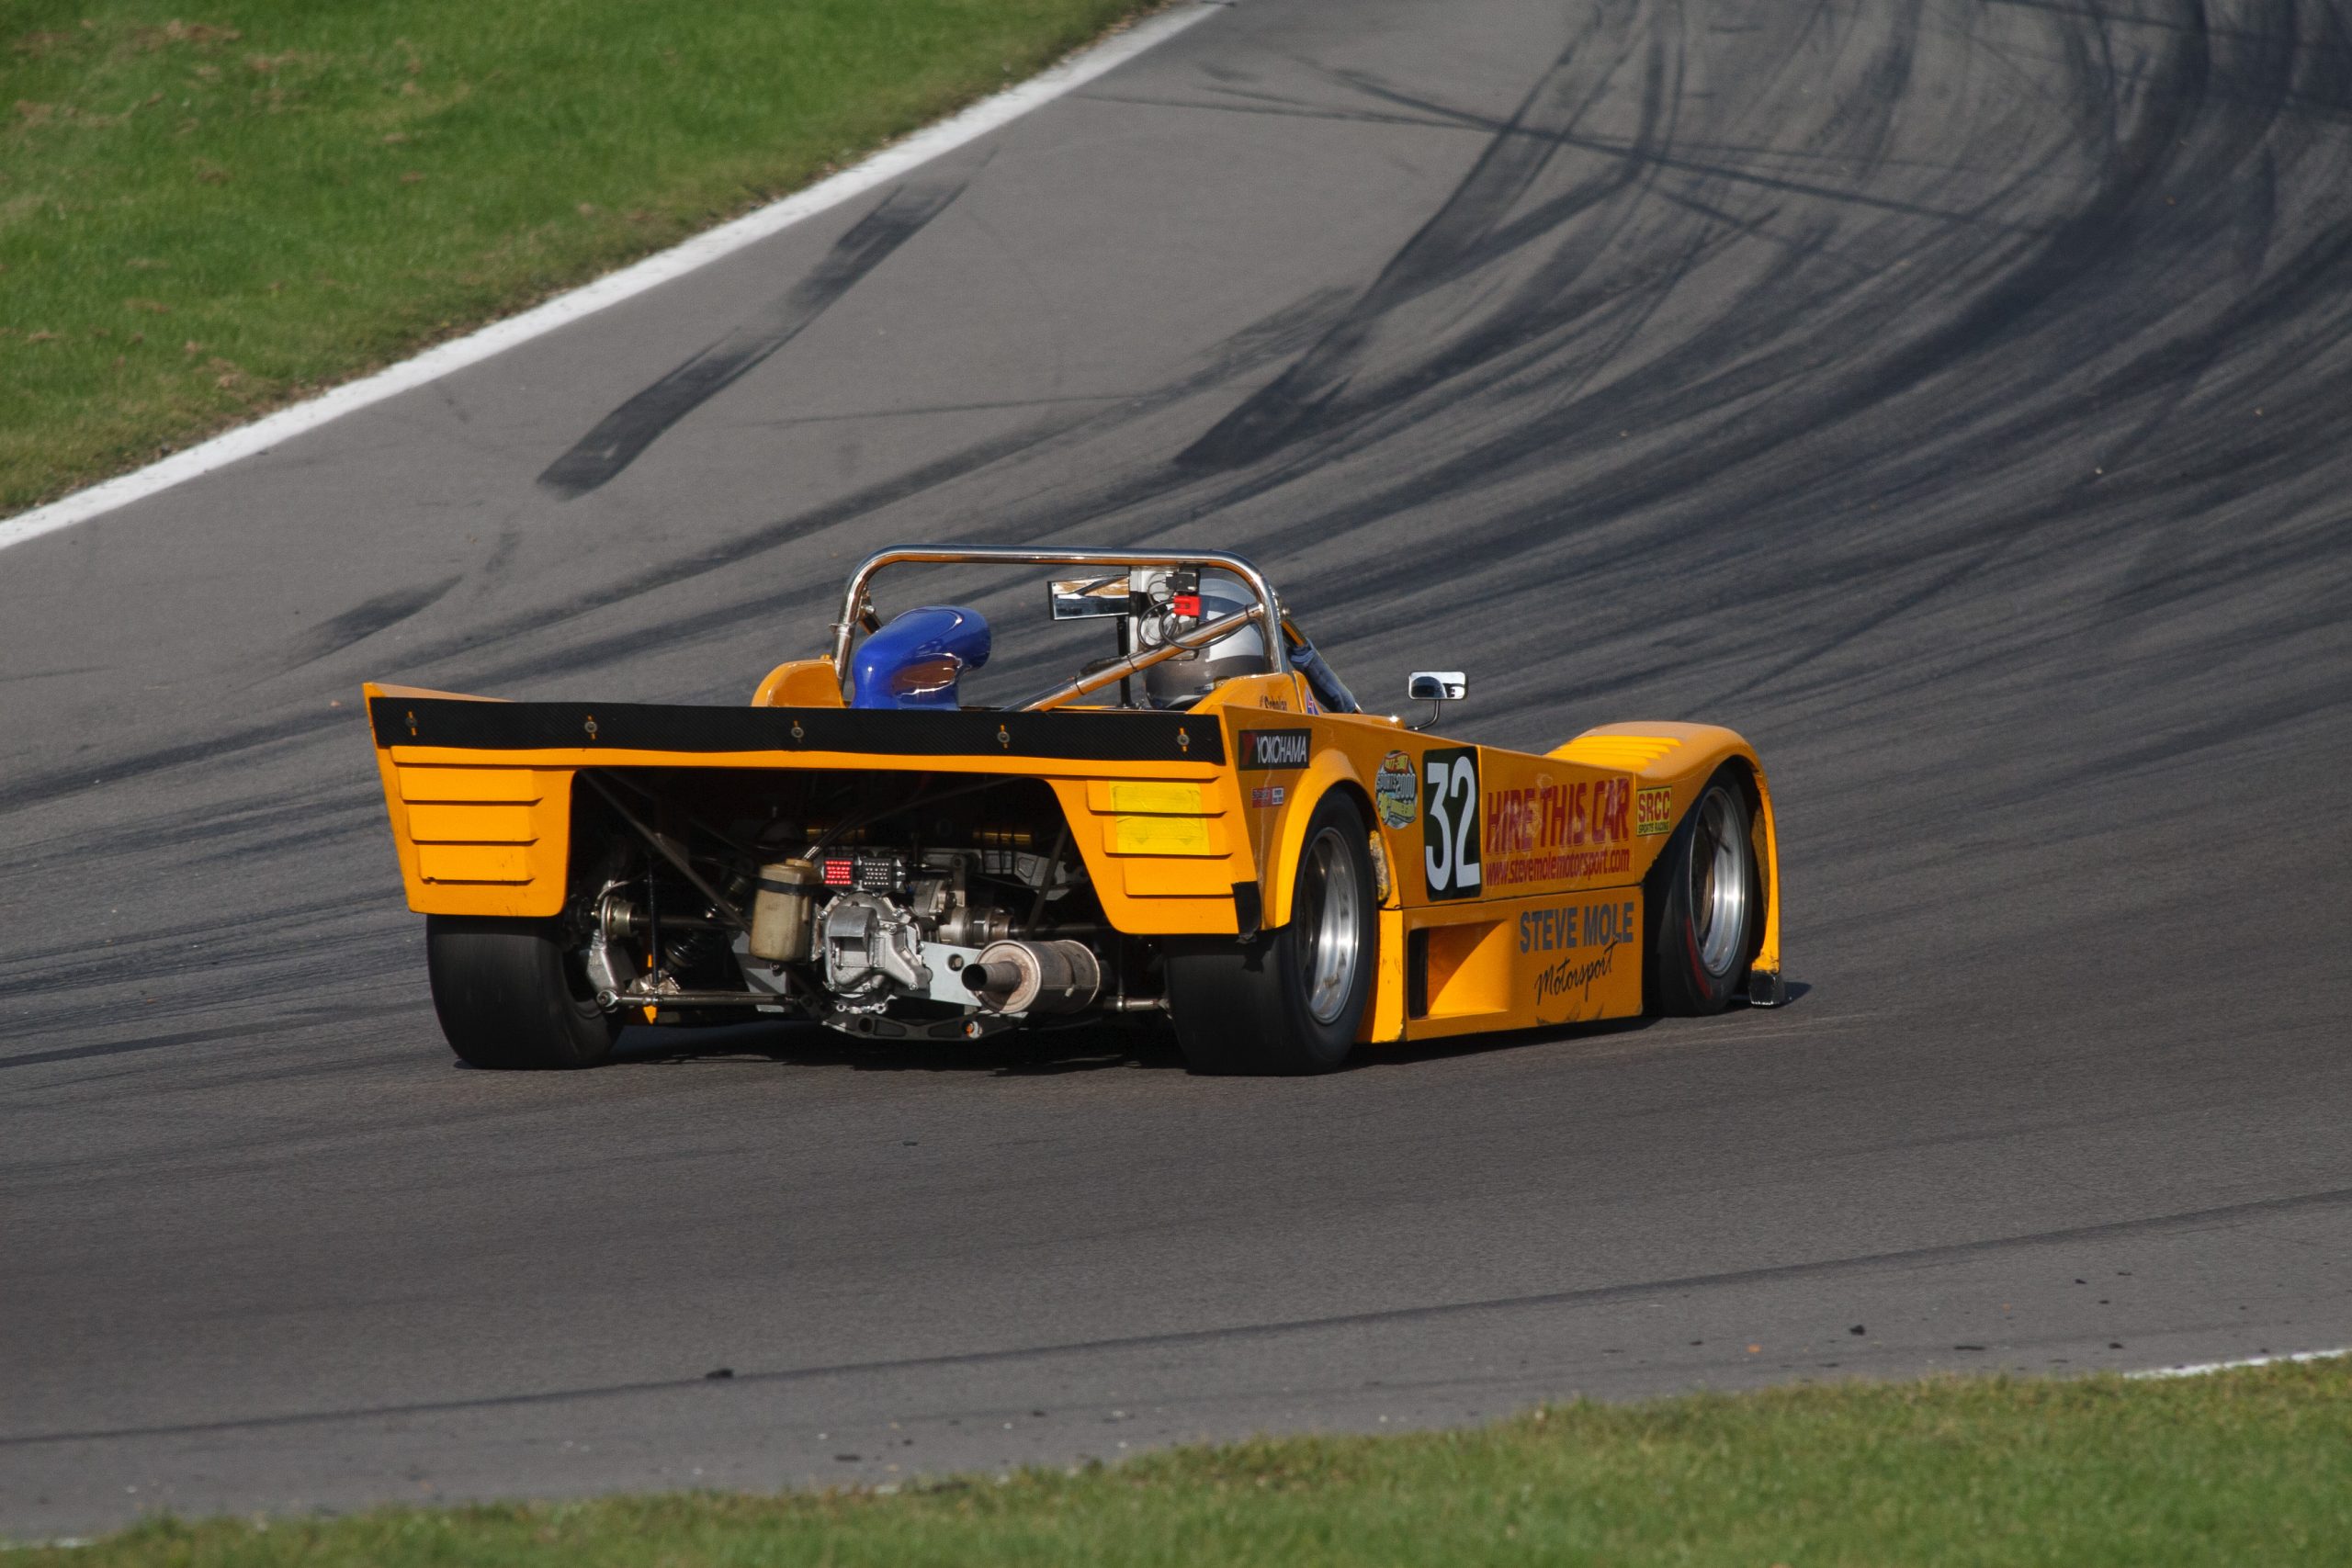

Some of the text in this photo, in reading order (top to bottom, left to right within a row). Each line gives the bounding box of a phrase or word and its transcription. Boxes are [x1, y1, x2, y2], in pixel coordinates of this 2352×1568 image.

[1257, 736, 1307, 764] YOKOHAMA
[1396, 773, 1416, 800] 2000
[1426, 756, 1480, 891] 32
[1486, 778, 1630, 855] HIRE THIS CAR
[1638, 791, 1669, 823] SRCC
[1639, 821, 1668, 834] SPORTS RACING
[1486, 849, 1630, 887] www.stevemolemotorsport.com
[1520, 901, 1634, 954] STEVE MOLE
[1534, 940, 1618, 1006] Motorsport
